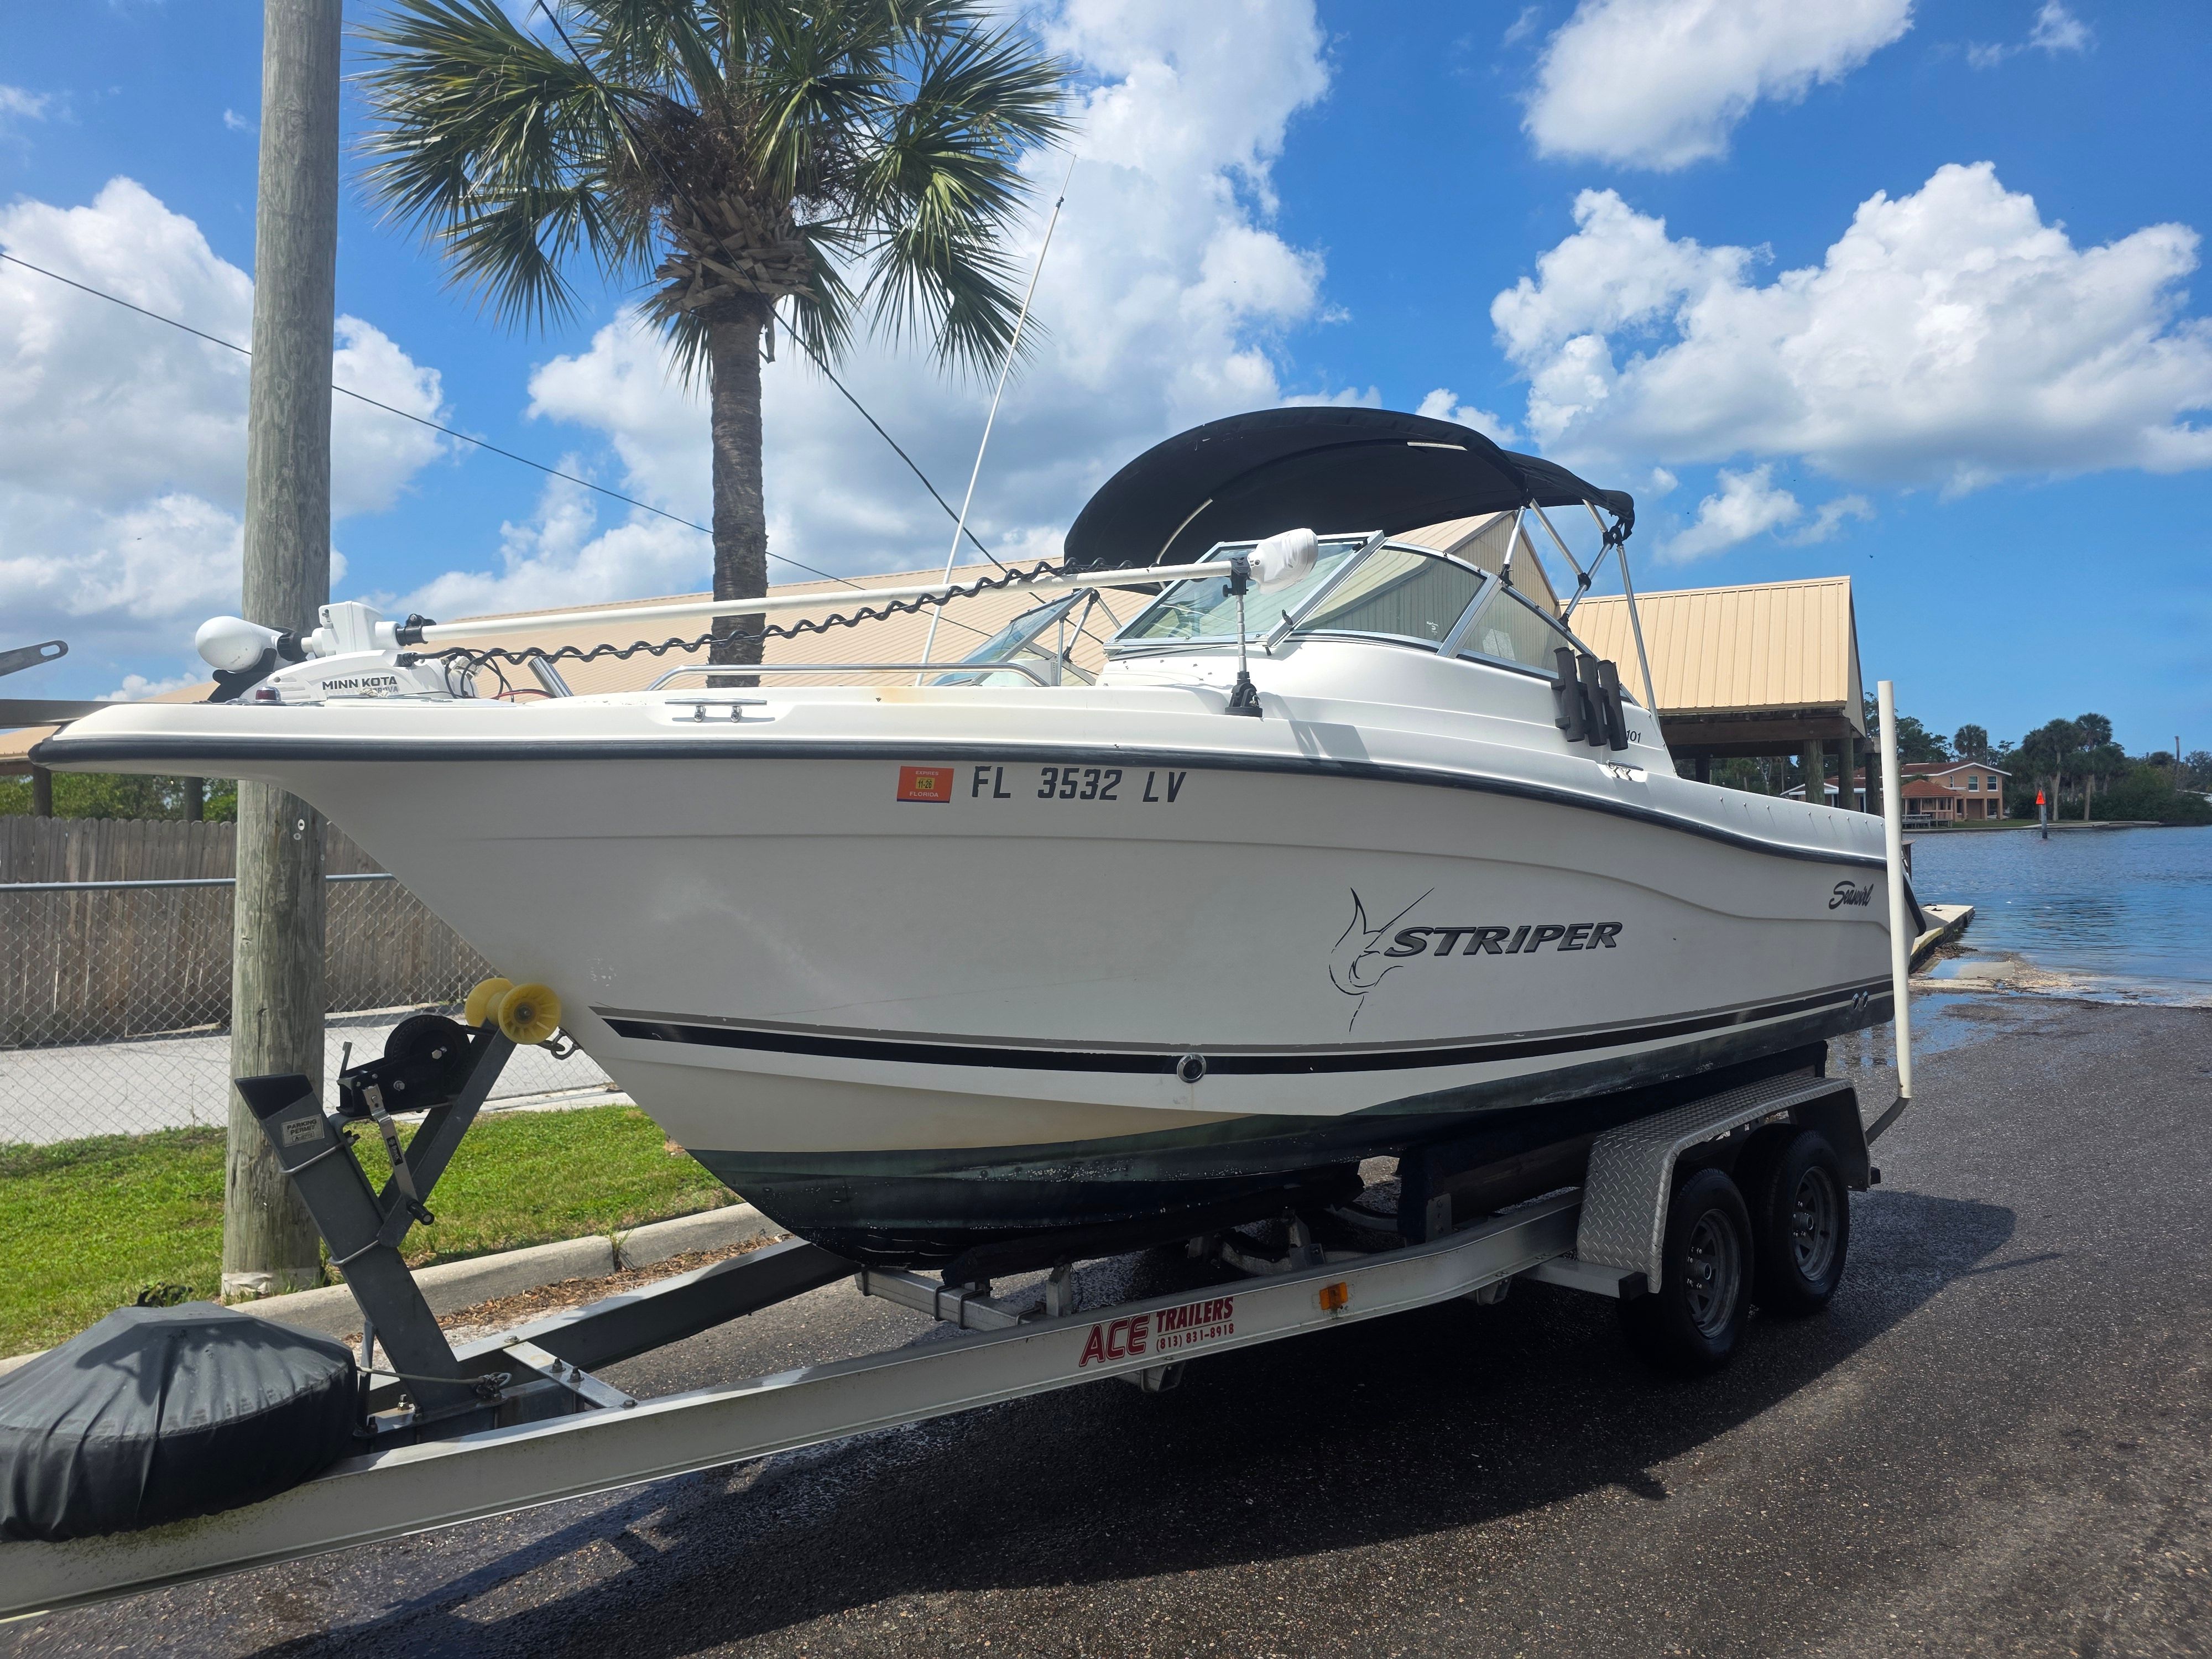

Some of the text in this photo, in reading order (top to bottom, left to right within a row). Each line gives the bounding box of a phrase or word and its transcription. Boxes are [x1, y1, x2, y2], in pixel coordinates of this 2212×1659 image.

[322, 676, 397, 690] MINN KOTA
[918, 780, 932, 789] 11-26
[972, 765, 1187, 802] FL 3532 LV
[1828, 880, 1874, 910] Seaswirl
[1384, 921, 1623, 957] STRIPER
[287, 1119, 317, 1130] PARKING
[290, 1125, 315, 1135] PERMIT
[1079, 1297, 1234, 1368] ACE TRAILERS
[1156, 1323, 1234, 1353] (813) 831-8918
